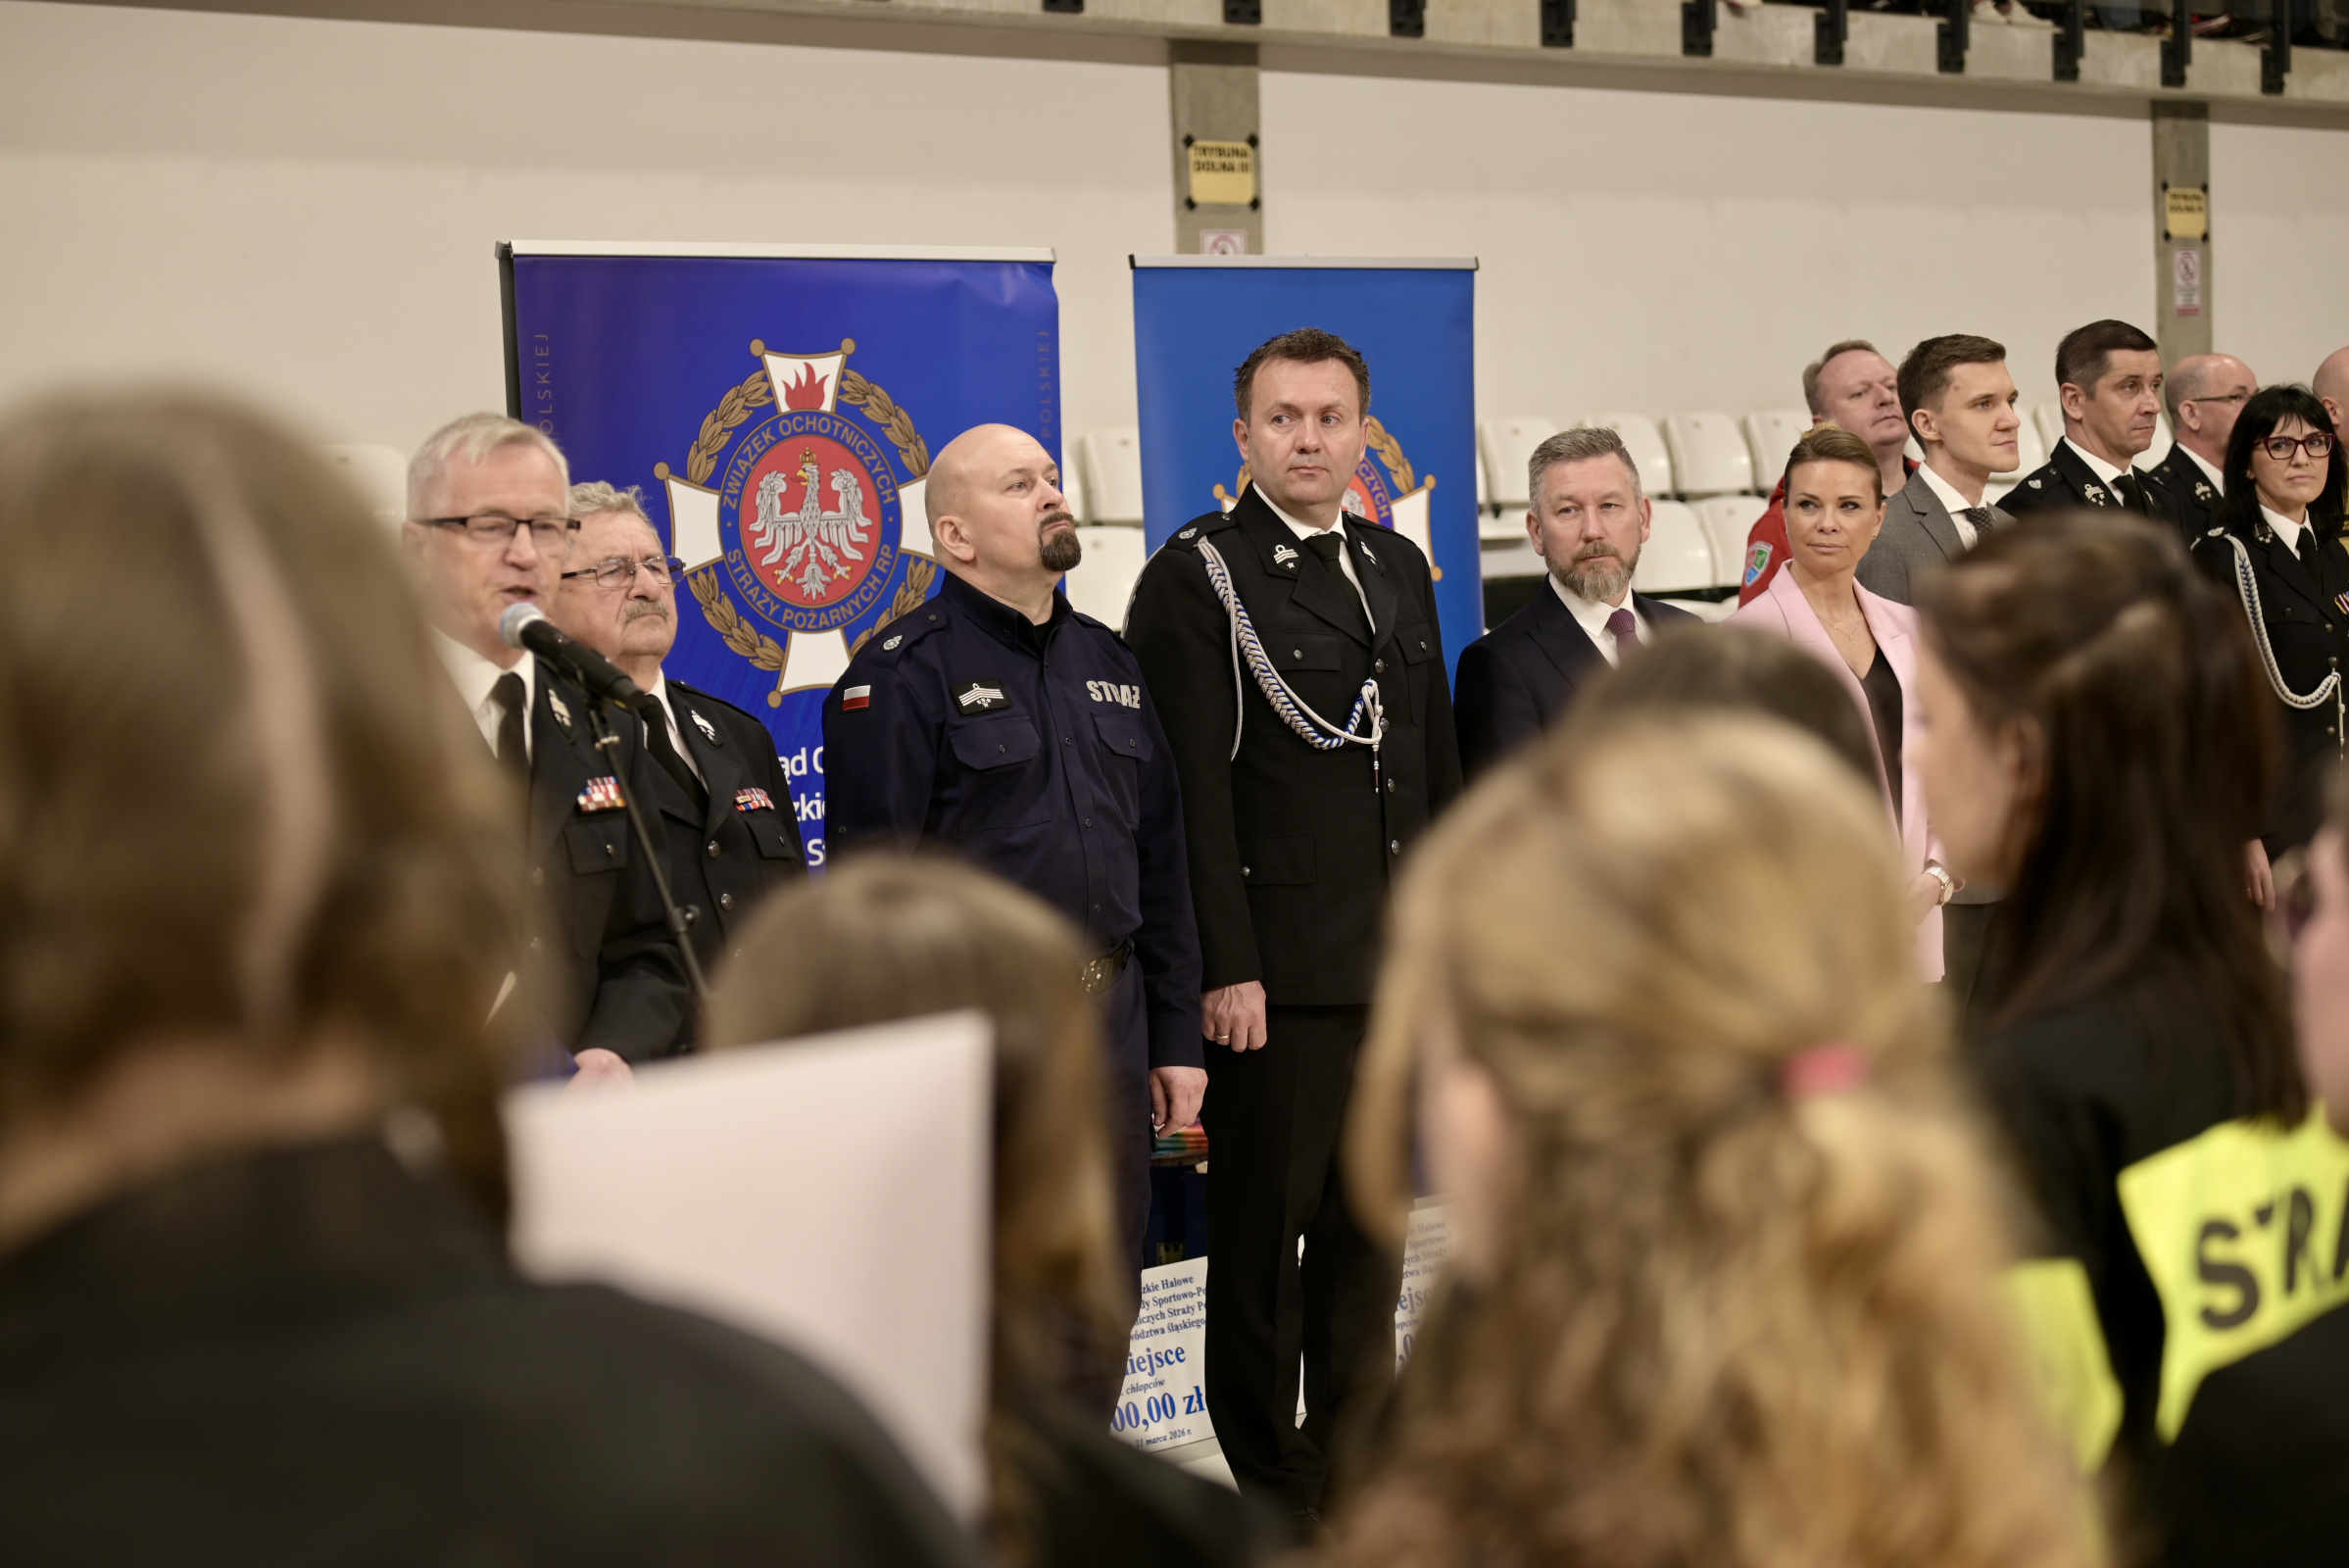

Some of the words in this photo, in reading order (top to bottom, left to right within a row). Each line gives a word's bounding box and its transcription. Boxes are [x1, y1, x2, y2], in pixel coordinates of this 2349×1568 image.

[534, 334, 555, 436] OLSKIEJ
[1037, 331, 1052, 438] POLSKIEJ
[723, 426, 777, 510] ZWIĄZEK
[778, 415, 896, 505] OCHOTNICZYCH
[727, 548, 780, 617] STRAŻY
[782, 575, 882, 629] POŻARNYCH
[875, 544, 894, 573] RP
[1161, 1276, 1194, 1290] Halowe
[1167, 1304, 1195, 1318] Straży
[1167, 1318, 1205, 1333] śląskiego
[1183, 1386, 1205, 1415] zł
[1146, 1437, 1167, 1446] marca
[1169, 1429, 1186, 1440] 2026
